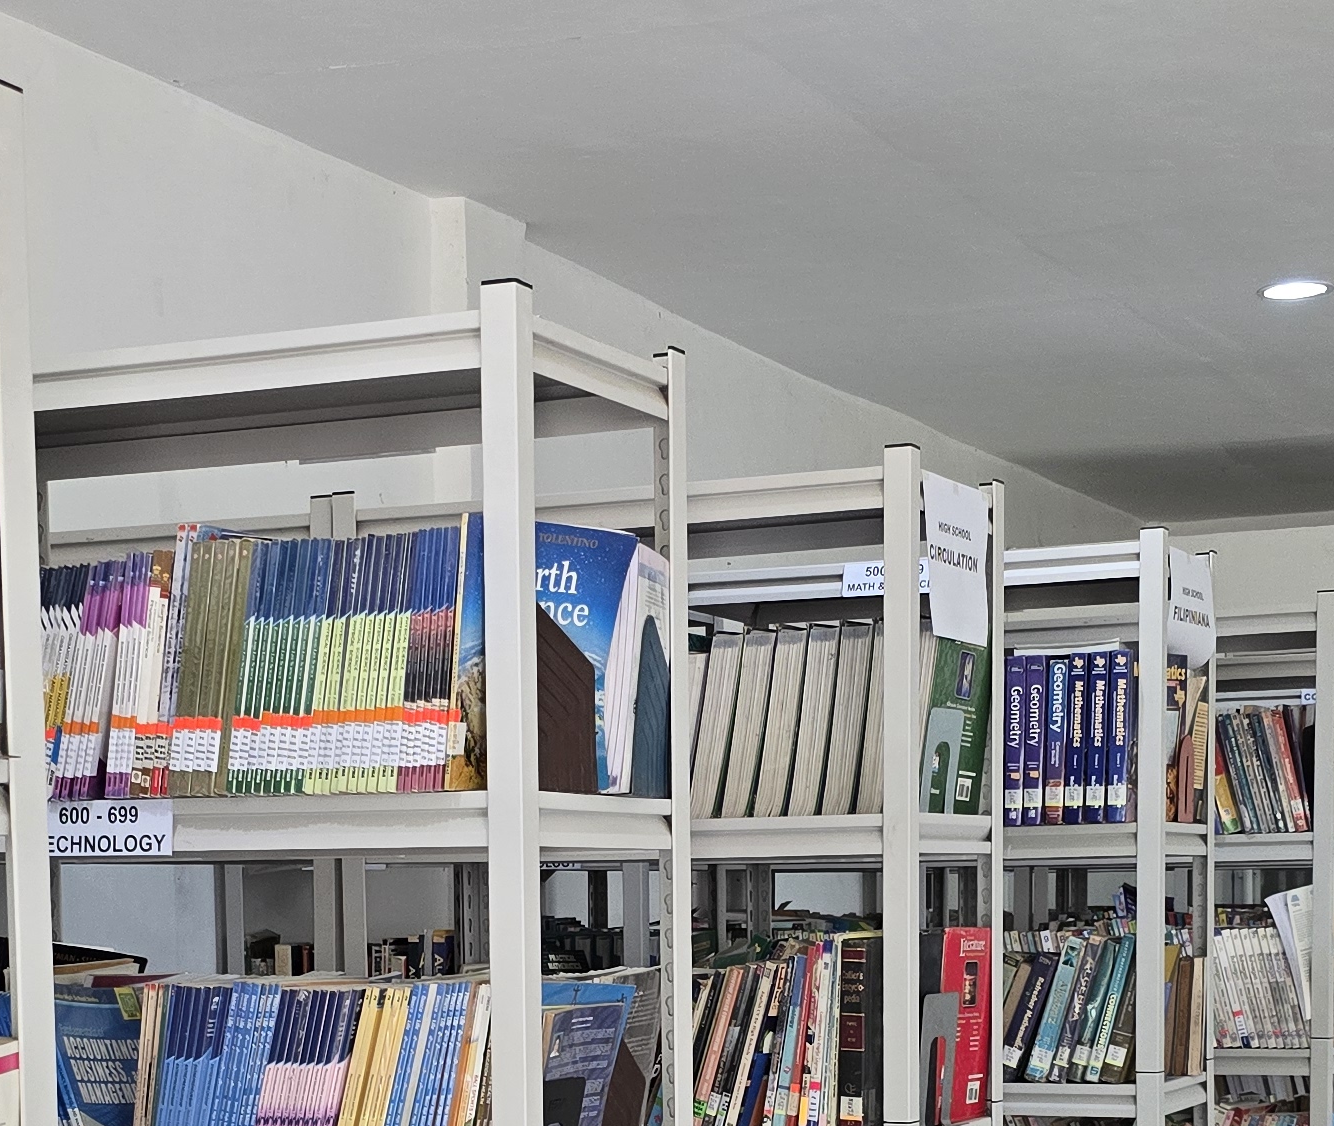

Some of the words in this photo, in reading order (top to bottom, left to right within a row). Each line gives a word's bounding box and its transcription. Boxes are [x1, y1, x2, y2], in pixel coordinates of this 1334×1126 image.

[539, 532, 599, 549] TOLENTINO
[938, 521, 952, 535] HIGH
[952, 526, 972, 541] SCHOOL
[929, 544, 978, 573] CIRCULATION
[535, 561, 578, 595] rth
[847, 583, 875, 591] MATH
[1173, 605, 1211, 629] FILIPINIANA
[1007, 686, 1022, 748] Geometry
[1027, 684, 1042, 747] Geometry
[1073, 681, 1084, 747] Mathematics
[1094, 680, 1105, 747] Mathematics
[59, 807, 90, 824] 600
[107, 806, 139, 823] 699
[48, 834, 186, 853] ECHNOLOGY
[842, 971, 863, 980] Collier's
[1025, 975, 1046, 1009] Refresher
[1095, 993, 1118, 1048] CONNECTIONS
[70, 1059, 131, 1083] BUSINESS,
[78, 1082, 136, 1104] MANAGEM
